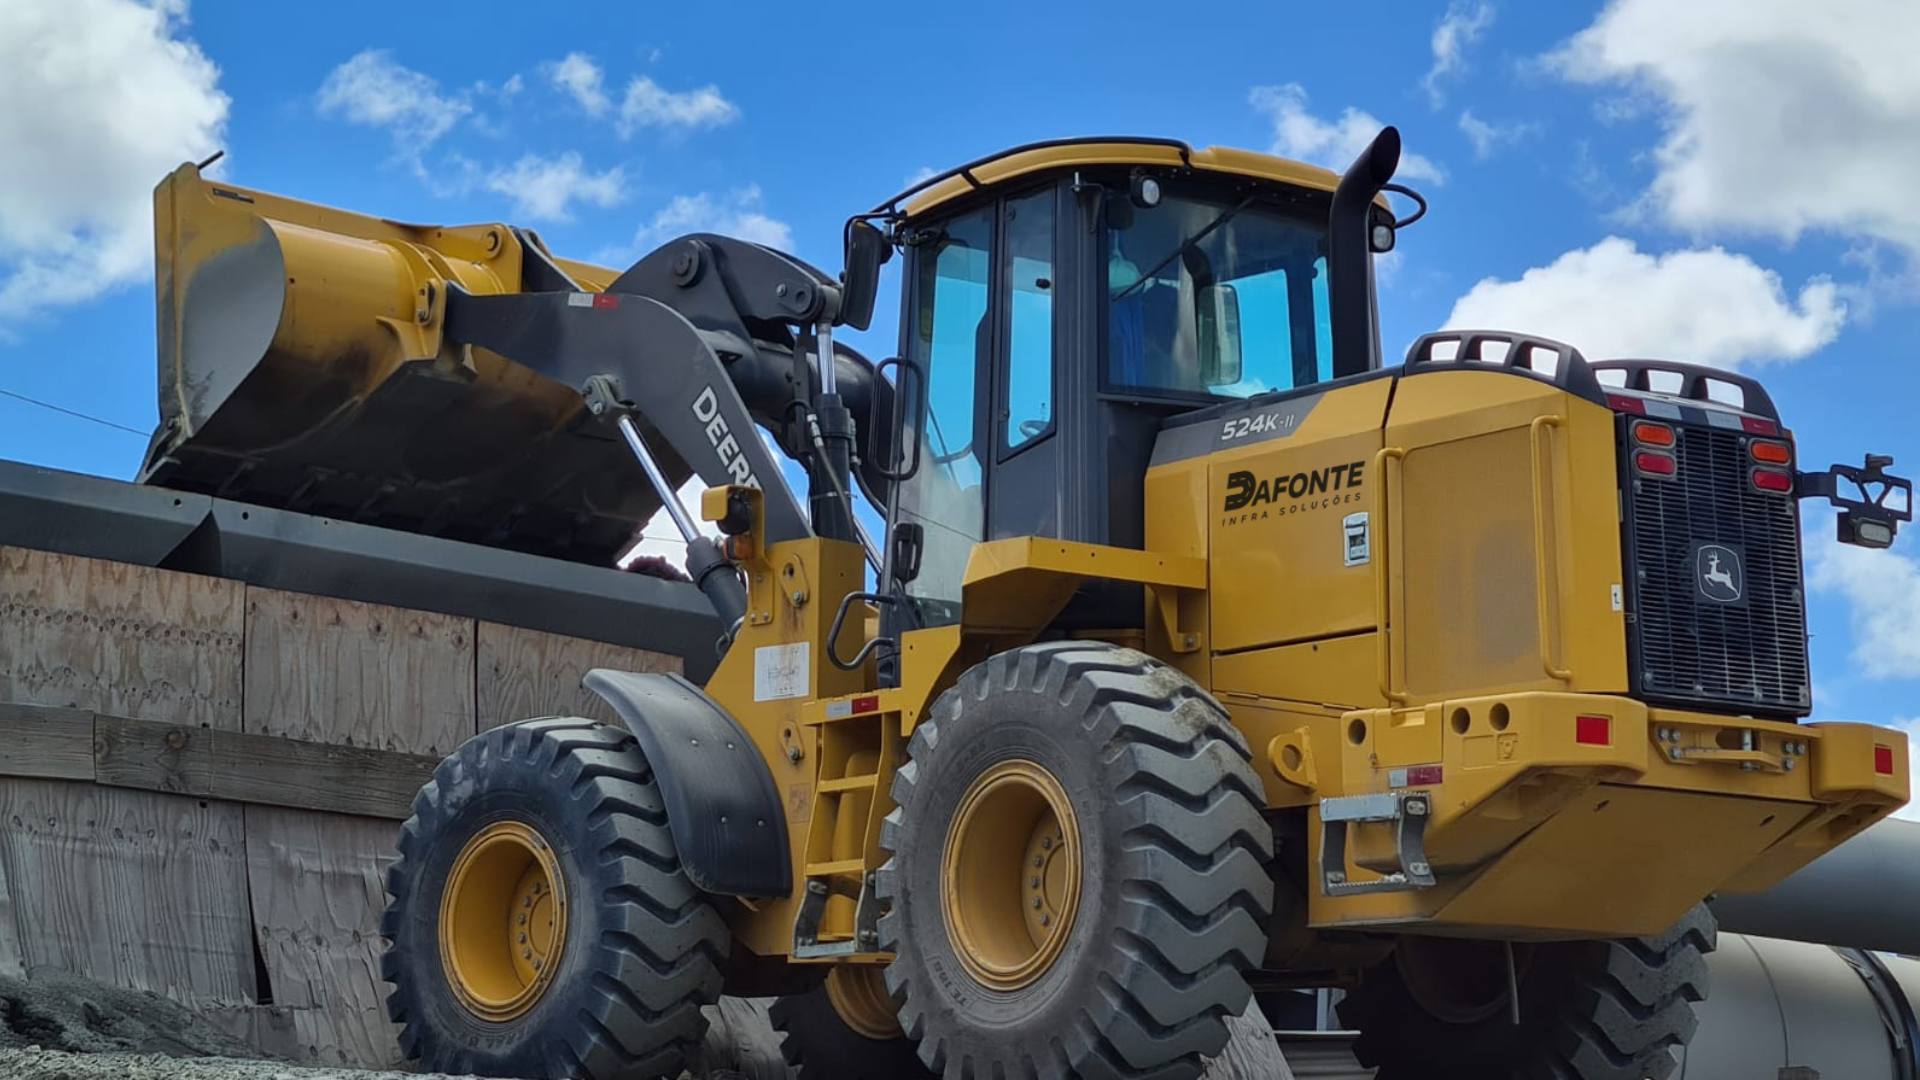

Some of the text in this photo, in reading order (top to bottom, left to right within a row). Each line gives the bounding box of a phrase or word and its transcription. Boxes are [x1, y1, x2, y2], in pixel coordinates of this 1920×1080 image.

[1221, 413, 1295, 440] 524K-II
[1224, 460, 1365, 512] DAFONTE
[1222, 492, 1361, 527] INFRA SOLUÇÕES
